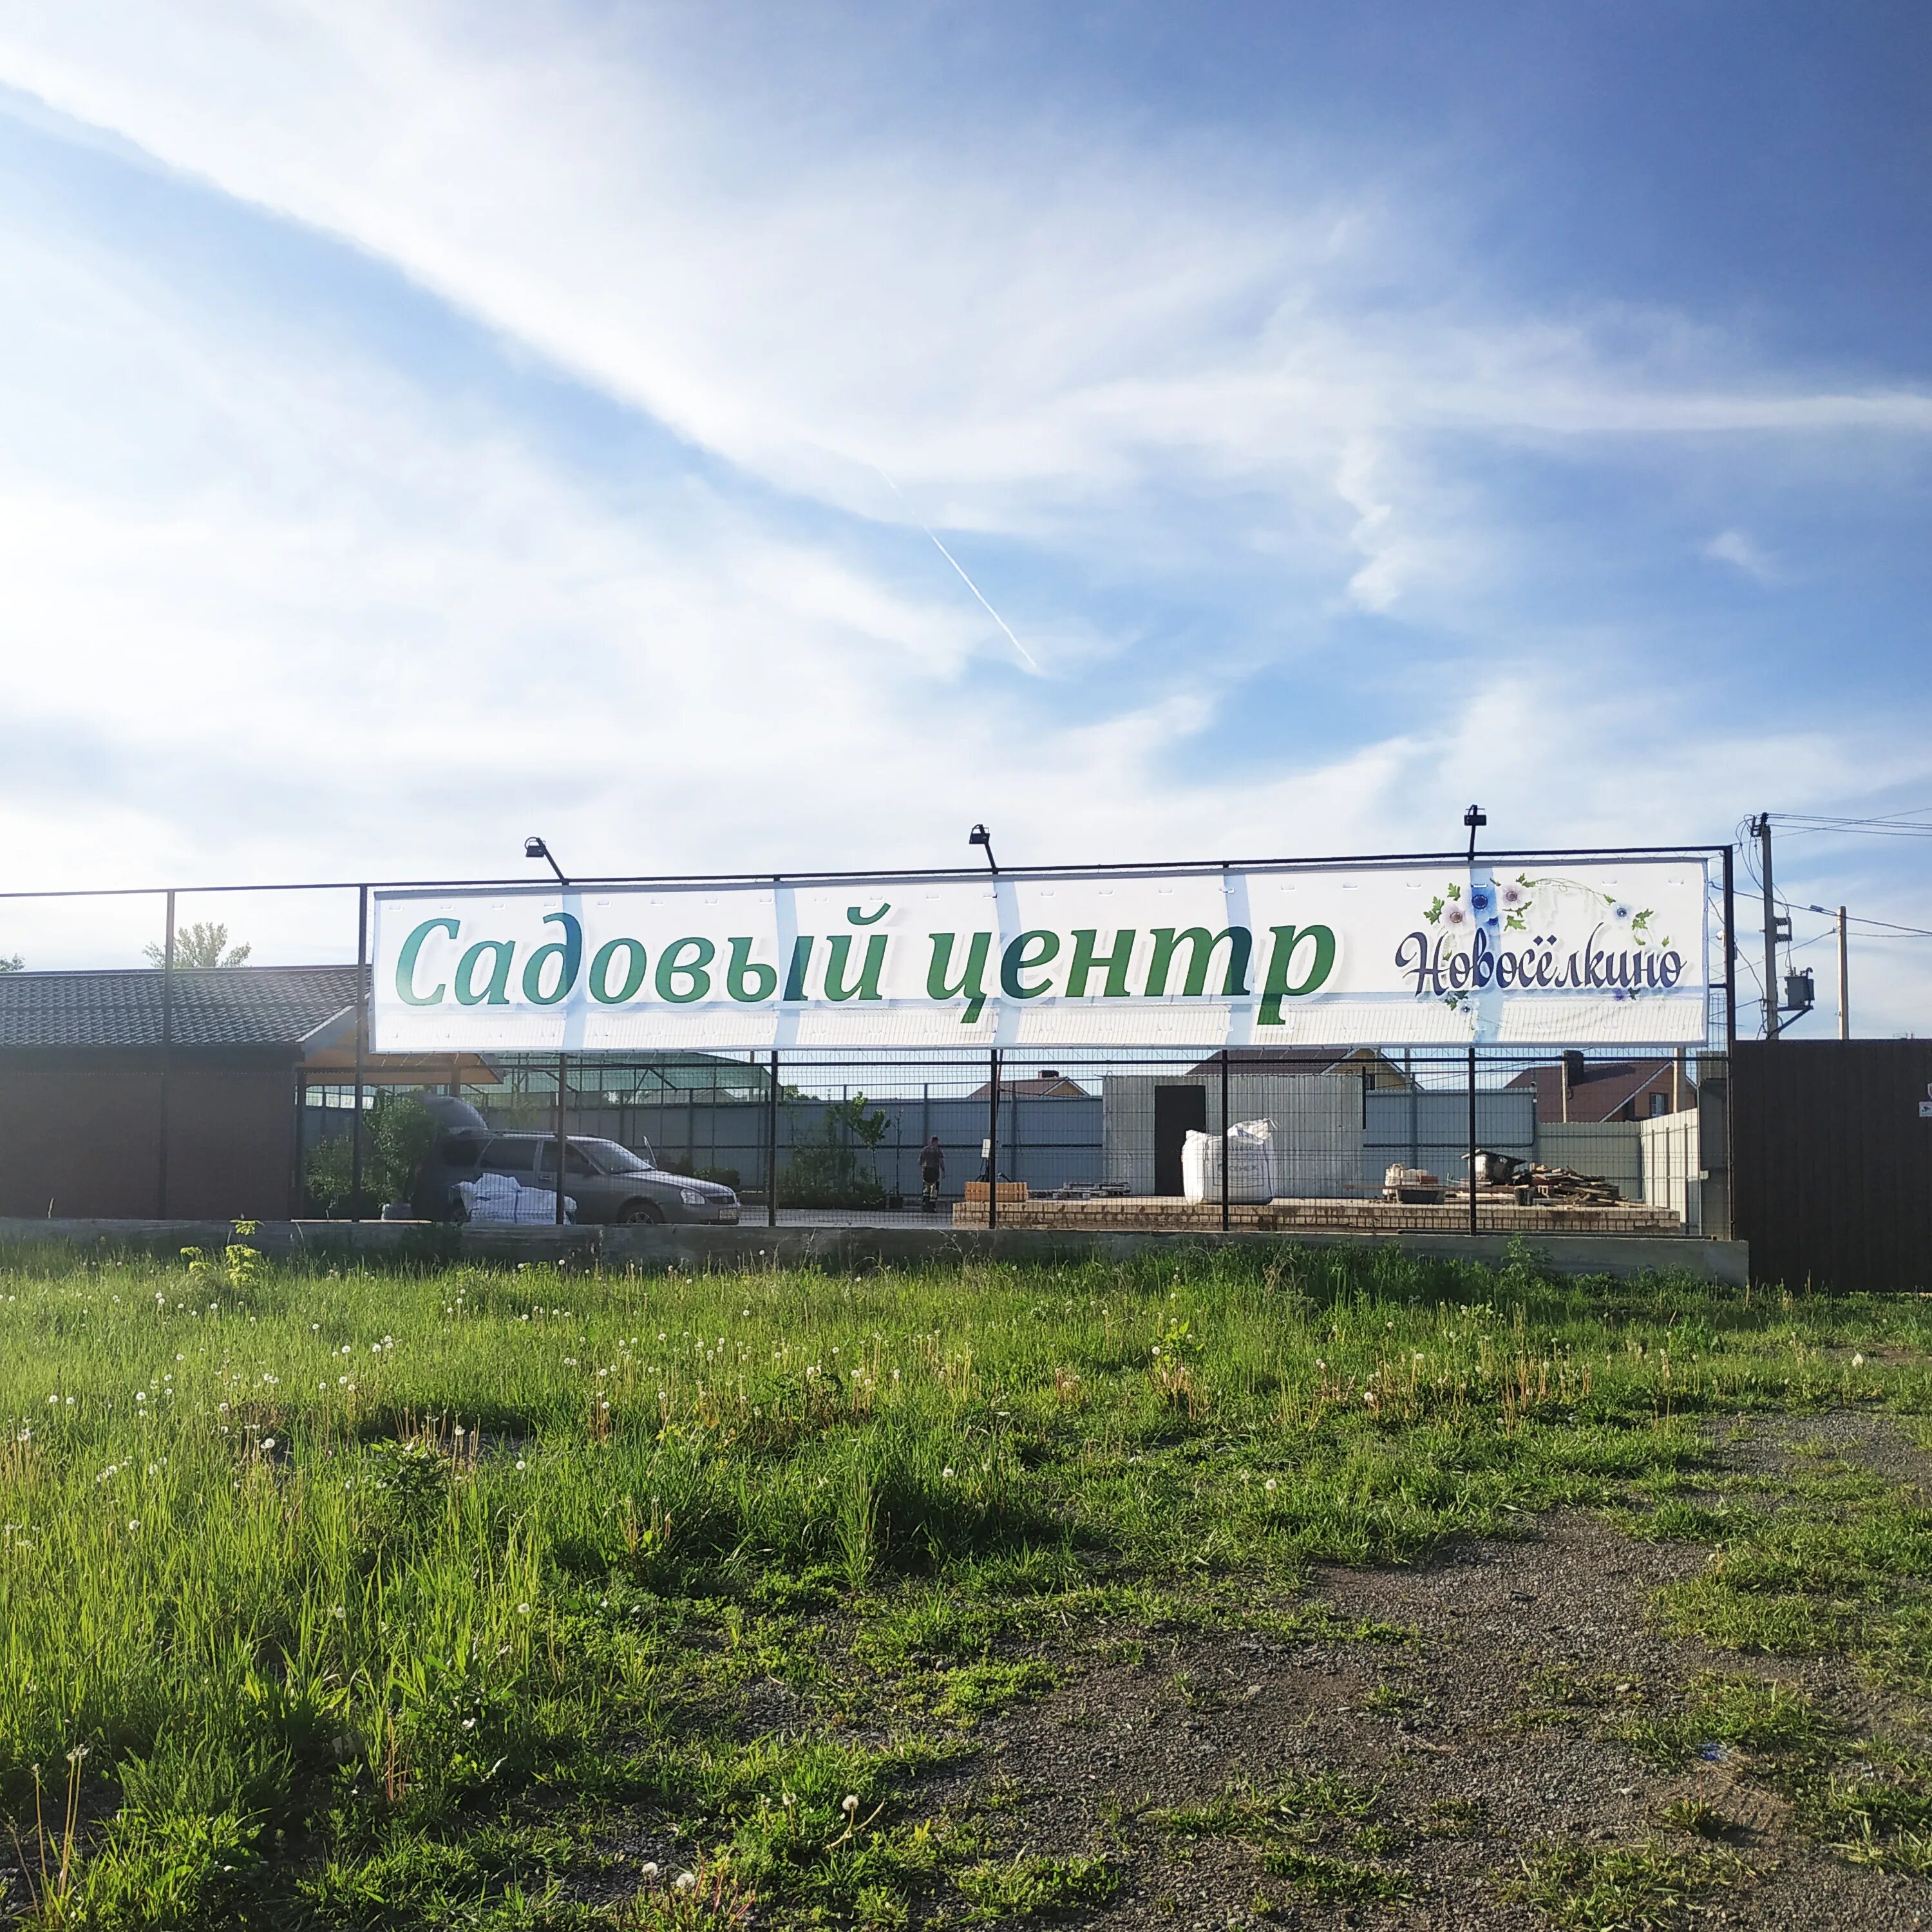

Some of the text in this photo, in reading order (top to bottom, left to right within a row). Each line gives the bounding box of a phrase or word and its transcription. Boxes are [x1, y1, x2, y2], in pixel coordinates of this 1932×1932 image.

[396, 903, 1336, 1025] Садовый центр
[1395, 922, 1687, 997] Новосёлкино
